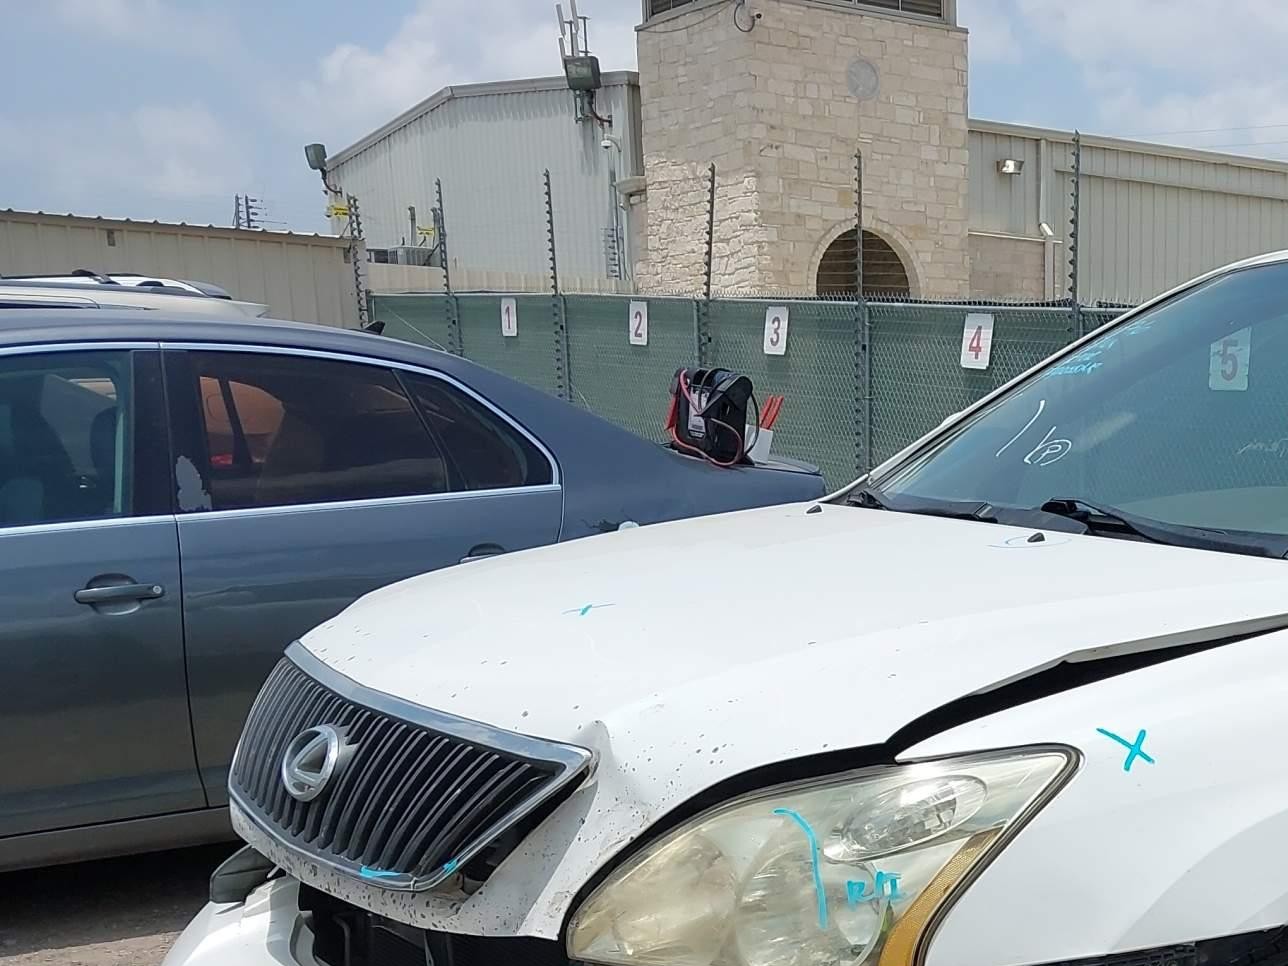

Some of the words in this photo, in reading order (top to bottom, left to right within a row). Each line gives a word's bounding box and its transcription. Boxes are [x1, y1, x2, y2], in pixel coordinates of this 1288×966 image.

[504, 305, 511, 330] 1
[633, 310, 643, 338] 2
[769, 316, 782, 347] 3
[968, 325, 983, 360] 4
[1220, 339, 1239, 382] 5
